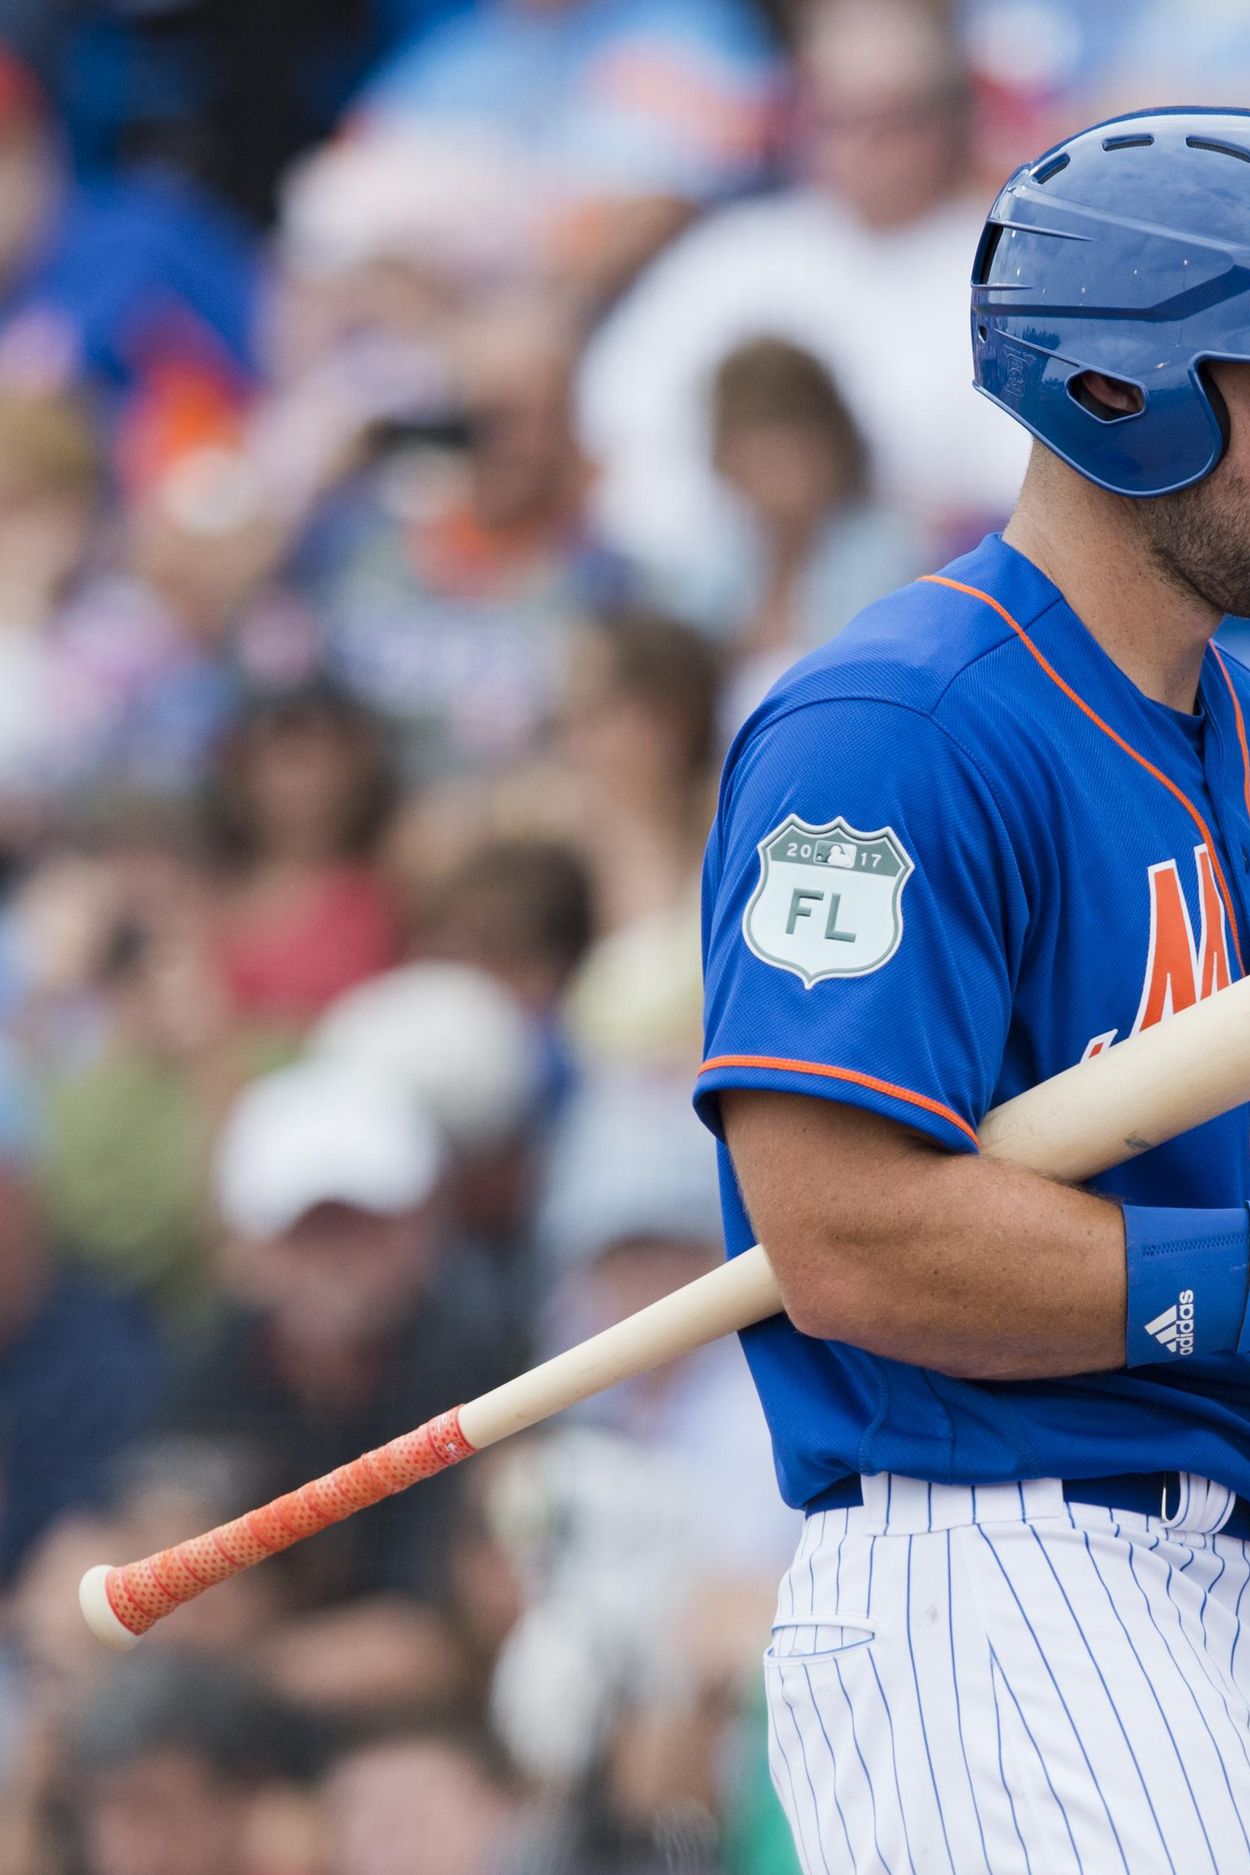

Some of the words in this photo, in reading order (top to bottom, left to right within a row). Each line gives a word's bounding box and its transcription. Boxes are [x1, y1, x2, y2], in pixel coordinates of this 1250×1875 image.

[786, 842, 811, 858] 20
[860, 852, 882, 868] 17
[785, 887, 857, 943] FL
[1176, 1289, 1194, 1356] adidas
